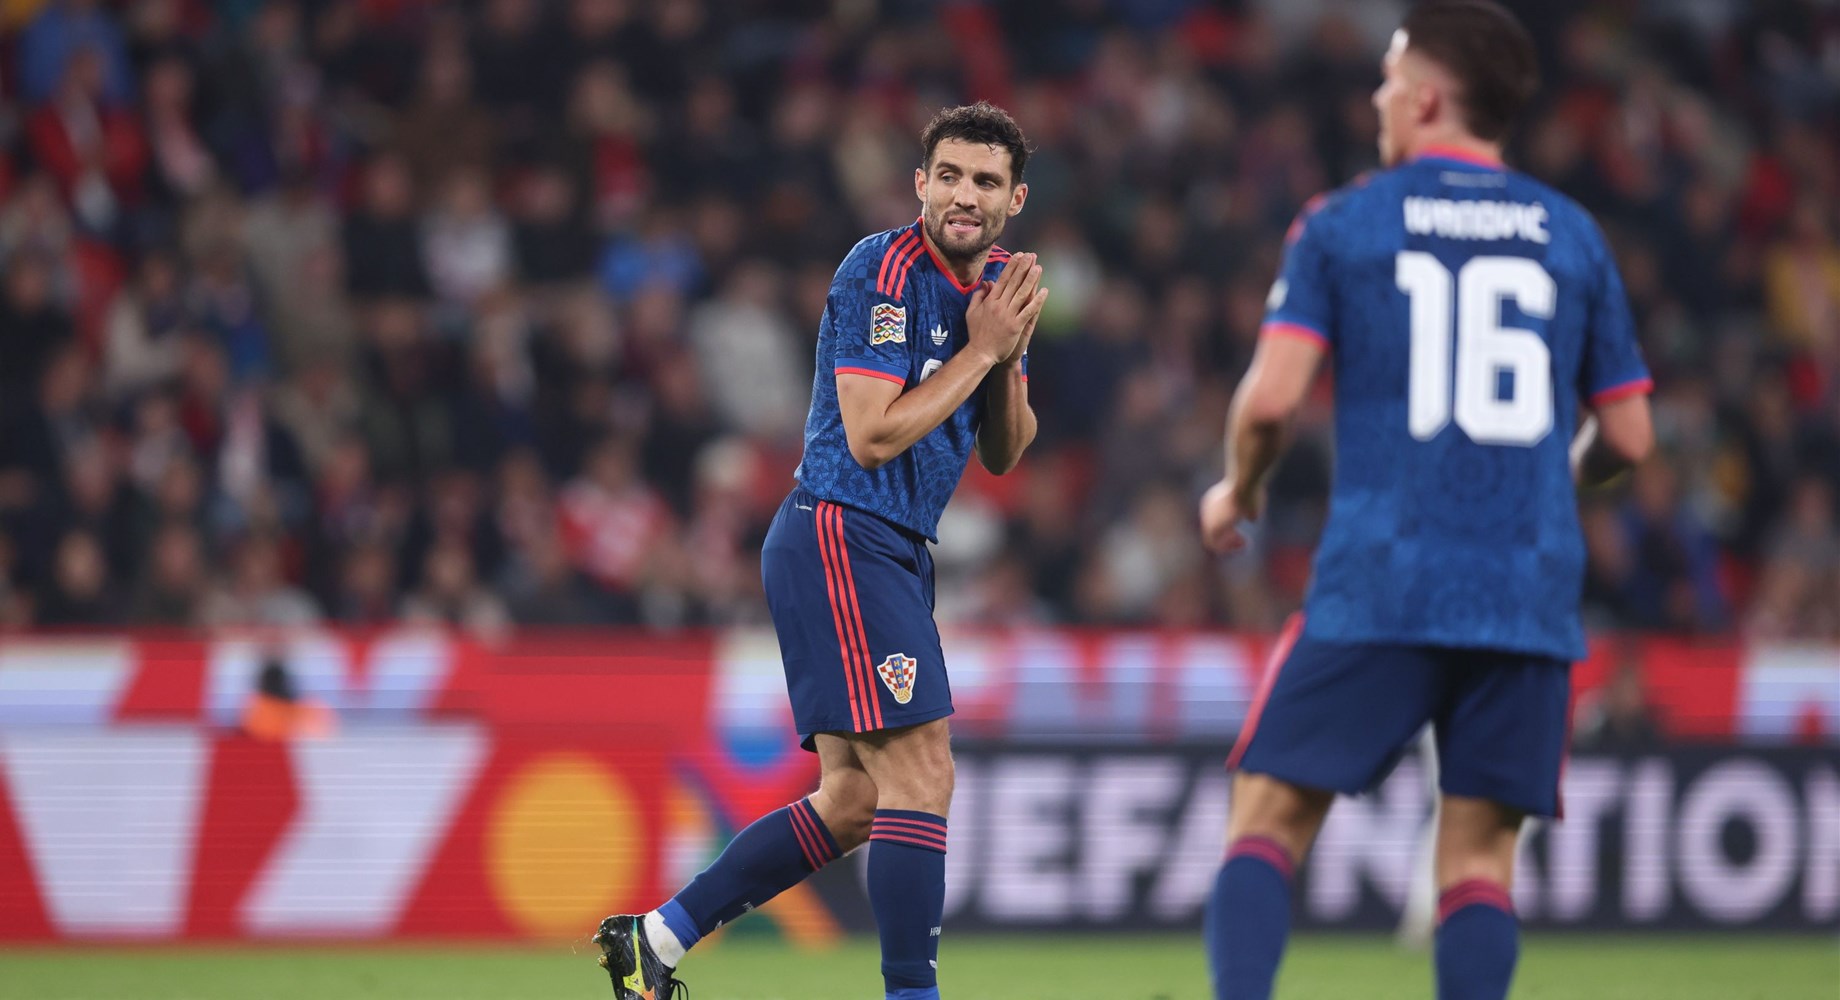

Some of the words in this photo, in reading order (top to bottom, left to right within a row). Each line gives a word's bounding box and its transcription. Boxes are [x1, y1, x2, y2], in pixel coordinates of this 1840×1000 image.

[1395, 250, 1557, 448] 16
[893, 660, 903, 684] HNS
[1305, 756, 1840, 924] NTIO
